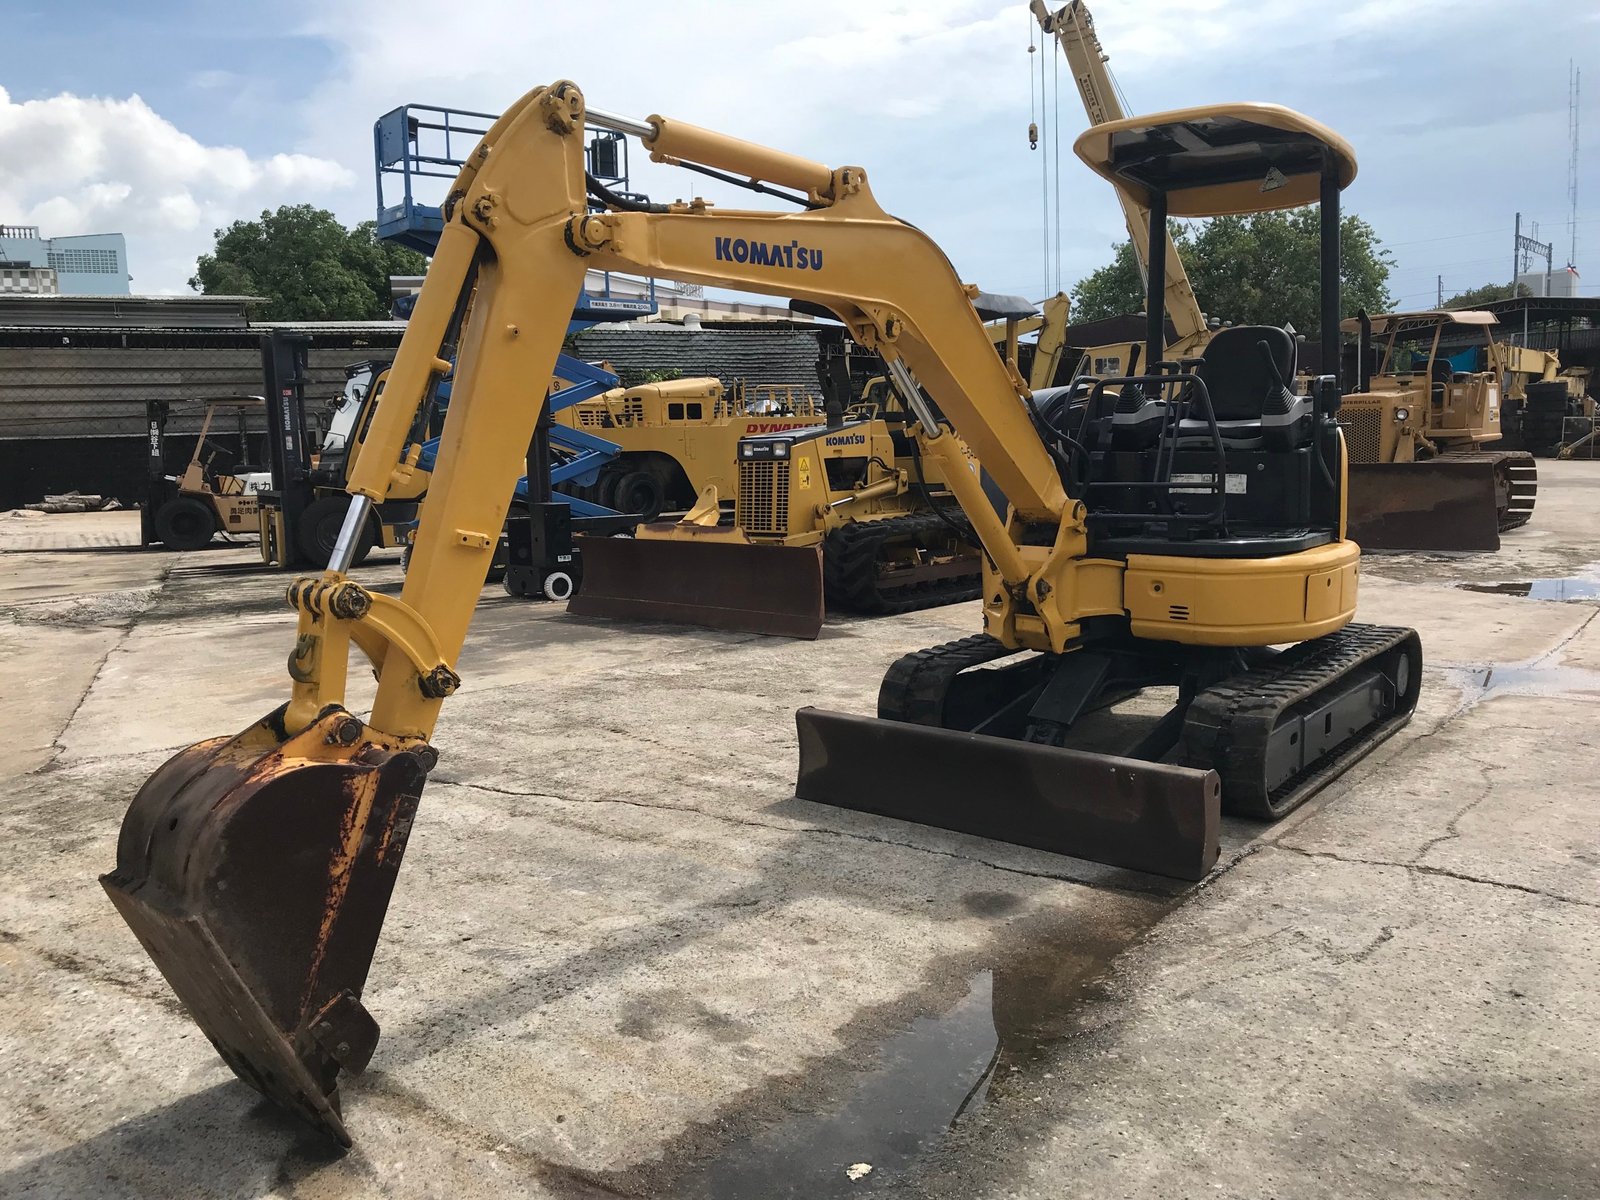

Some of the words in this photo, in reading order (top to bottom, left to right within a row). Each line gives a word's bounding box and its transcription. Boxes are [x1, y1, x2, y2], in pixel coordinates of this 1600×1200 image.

[715, 236, 823, 271] KOMATSU
[282, 397, 291, 431] KOMATSU
[825, 433, 865, 446] KOMATSU
